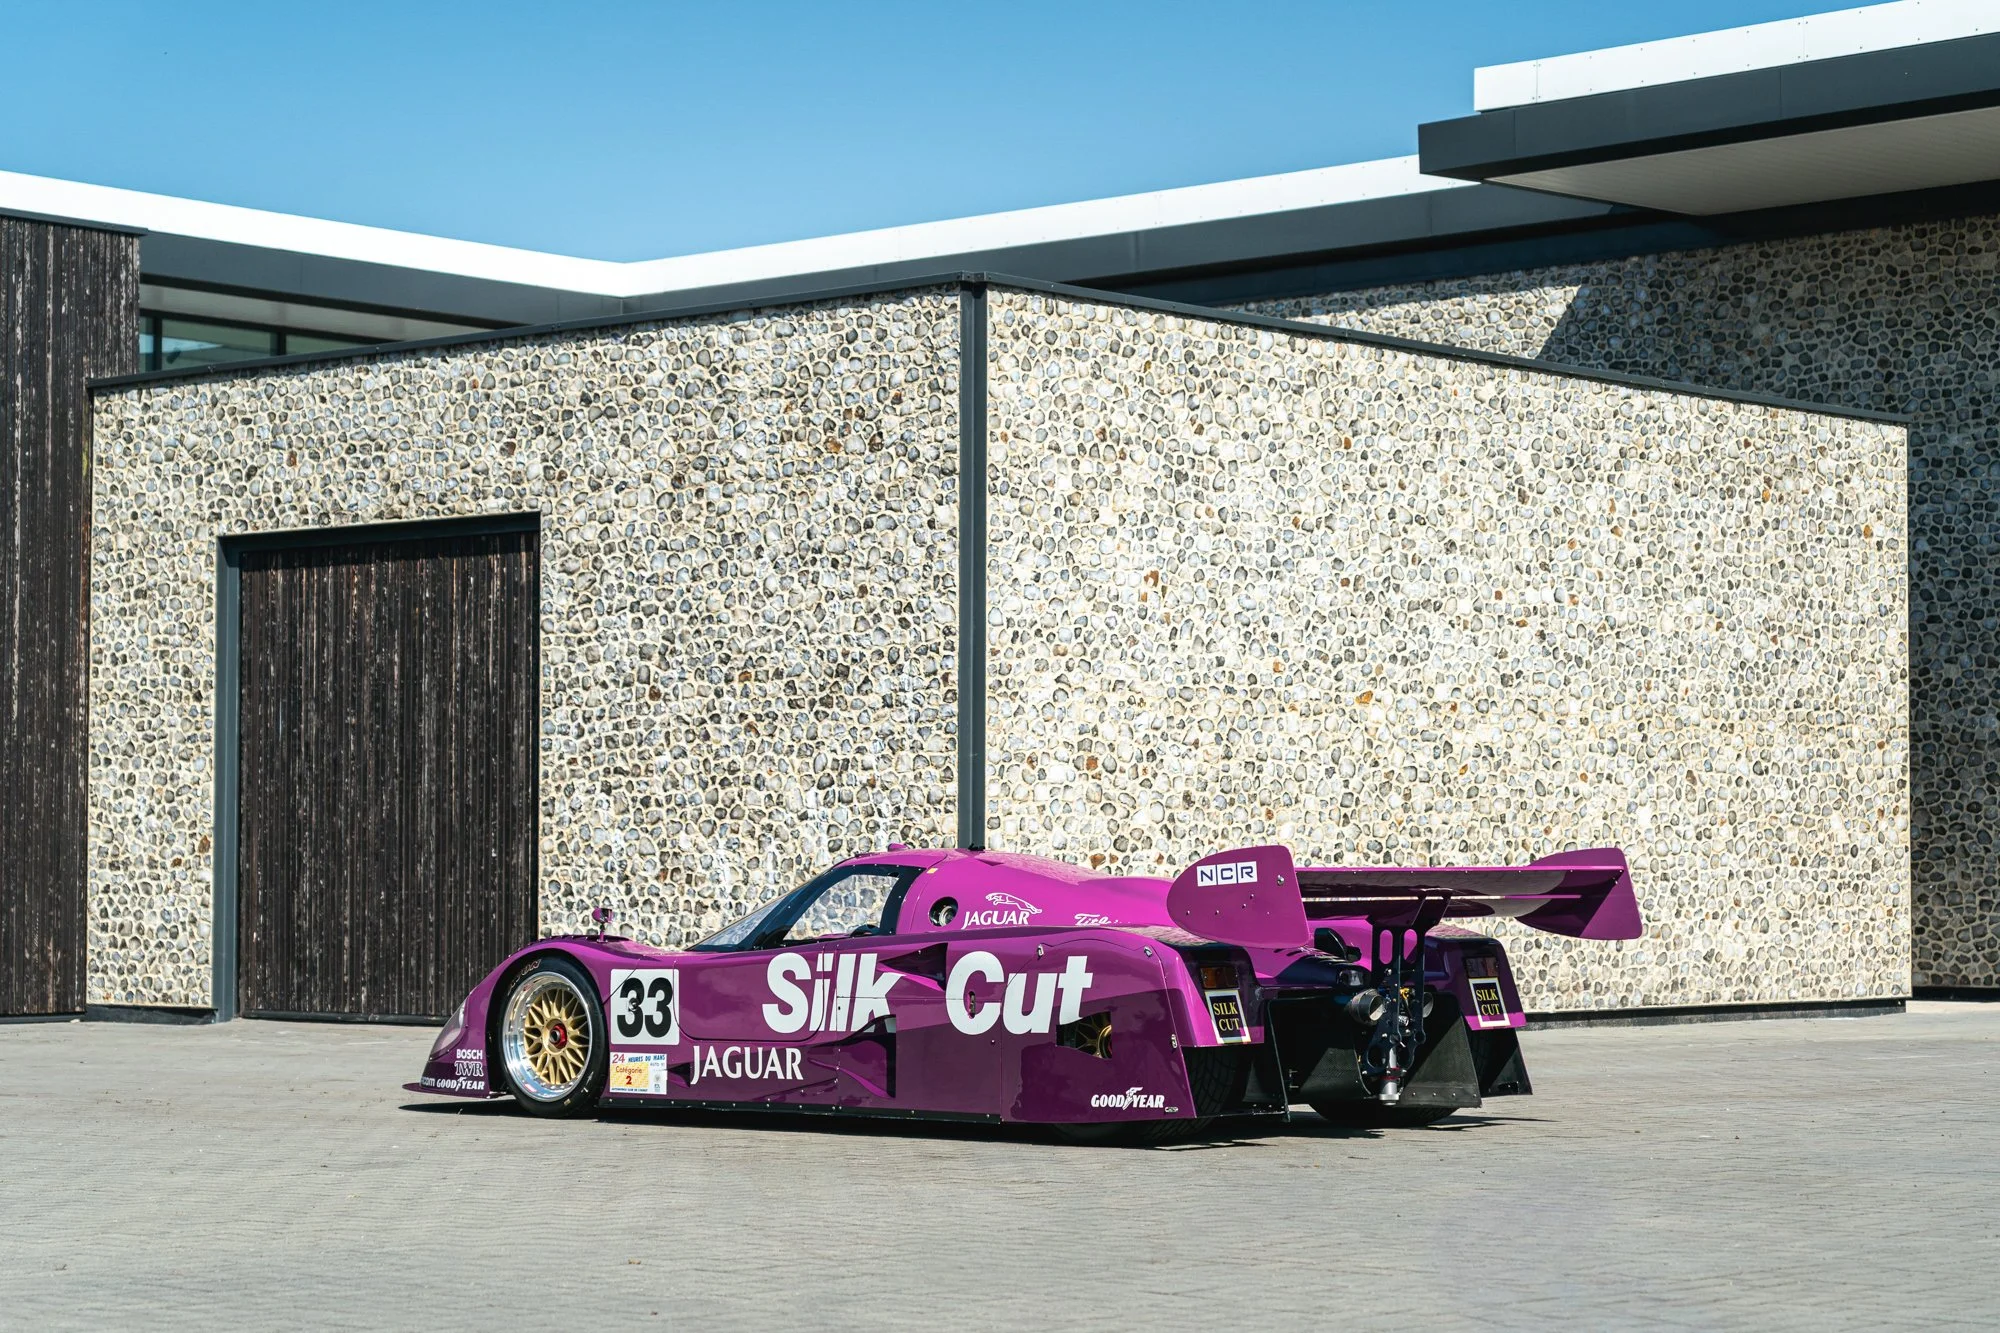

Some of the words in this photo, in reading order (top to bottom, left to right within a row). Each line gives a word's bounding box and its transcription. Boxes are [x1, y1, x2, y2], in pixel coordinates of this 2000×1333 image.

[1200, 866, 1254, 882] NCR
[961, 910, 1030, 930] JAGUAR
[761, 952, 906, 1034] Silk
[945, 951, 1093, 1035] Cut
[1476, 989, 1499, 1001] SILK
[617, 977, 673, 1038] 33
[1213, 1002, 1238, 1015] SILK
[1481, 1004, 1500, 1016] CUT
[1218, 1018, 1240, 1031] CUT
[456, 1049, 483, 1060] BOSCH
[612, 1054, 625, 1064] 24
[454, 1061, 484, 1076] TWR
[690, 1045, 804, 1085] JAGUAR
[625, 1075, 632, 1085] 2
